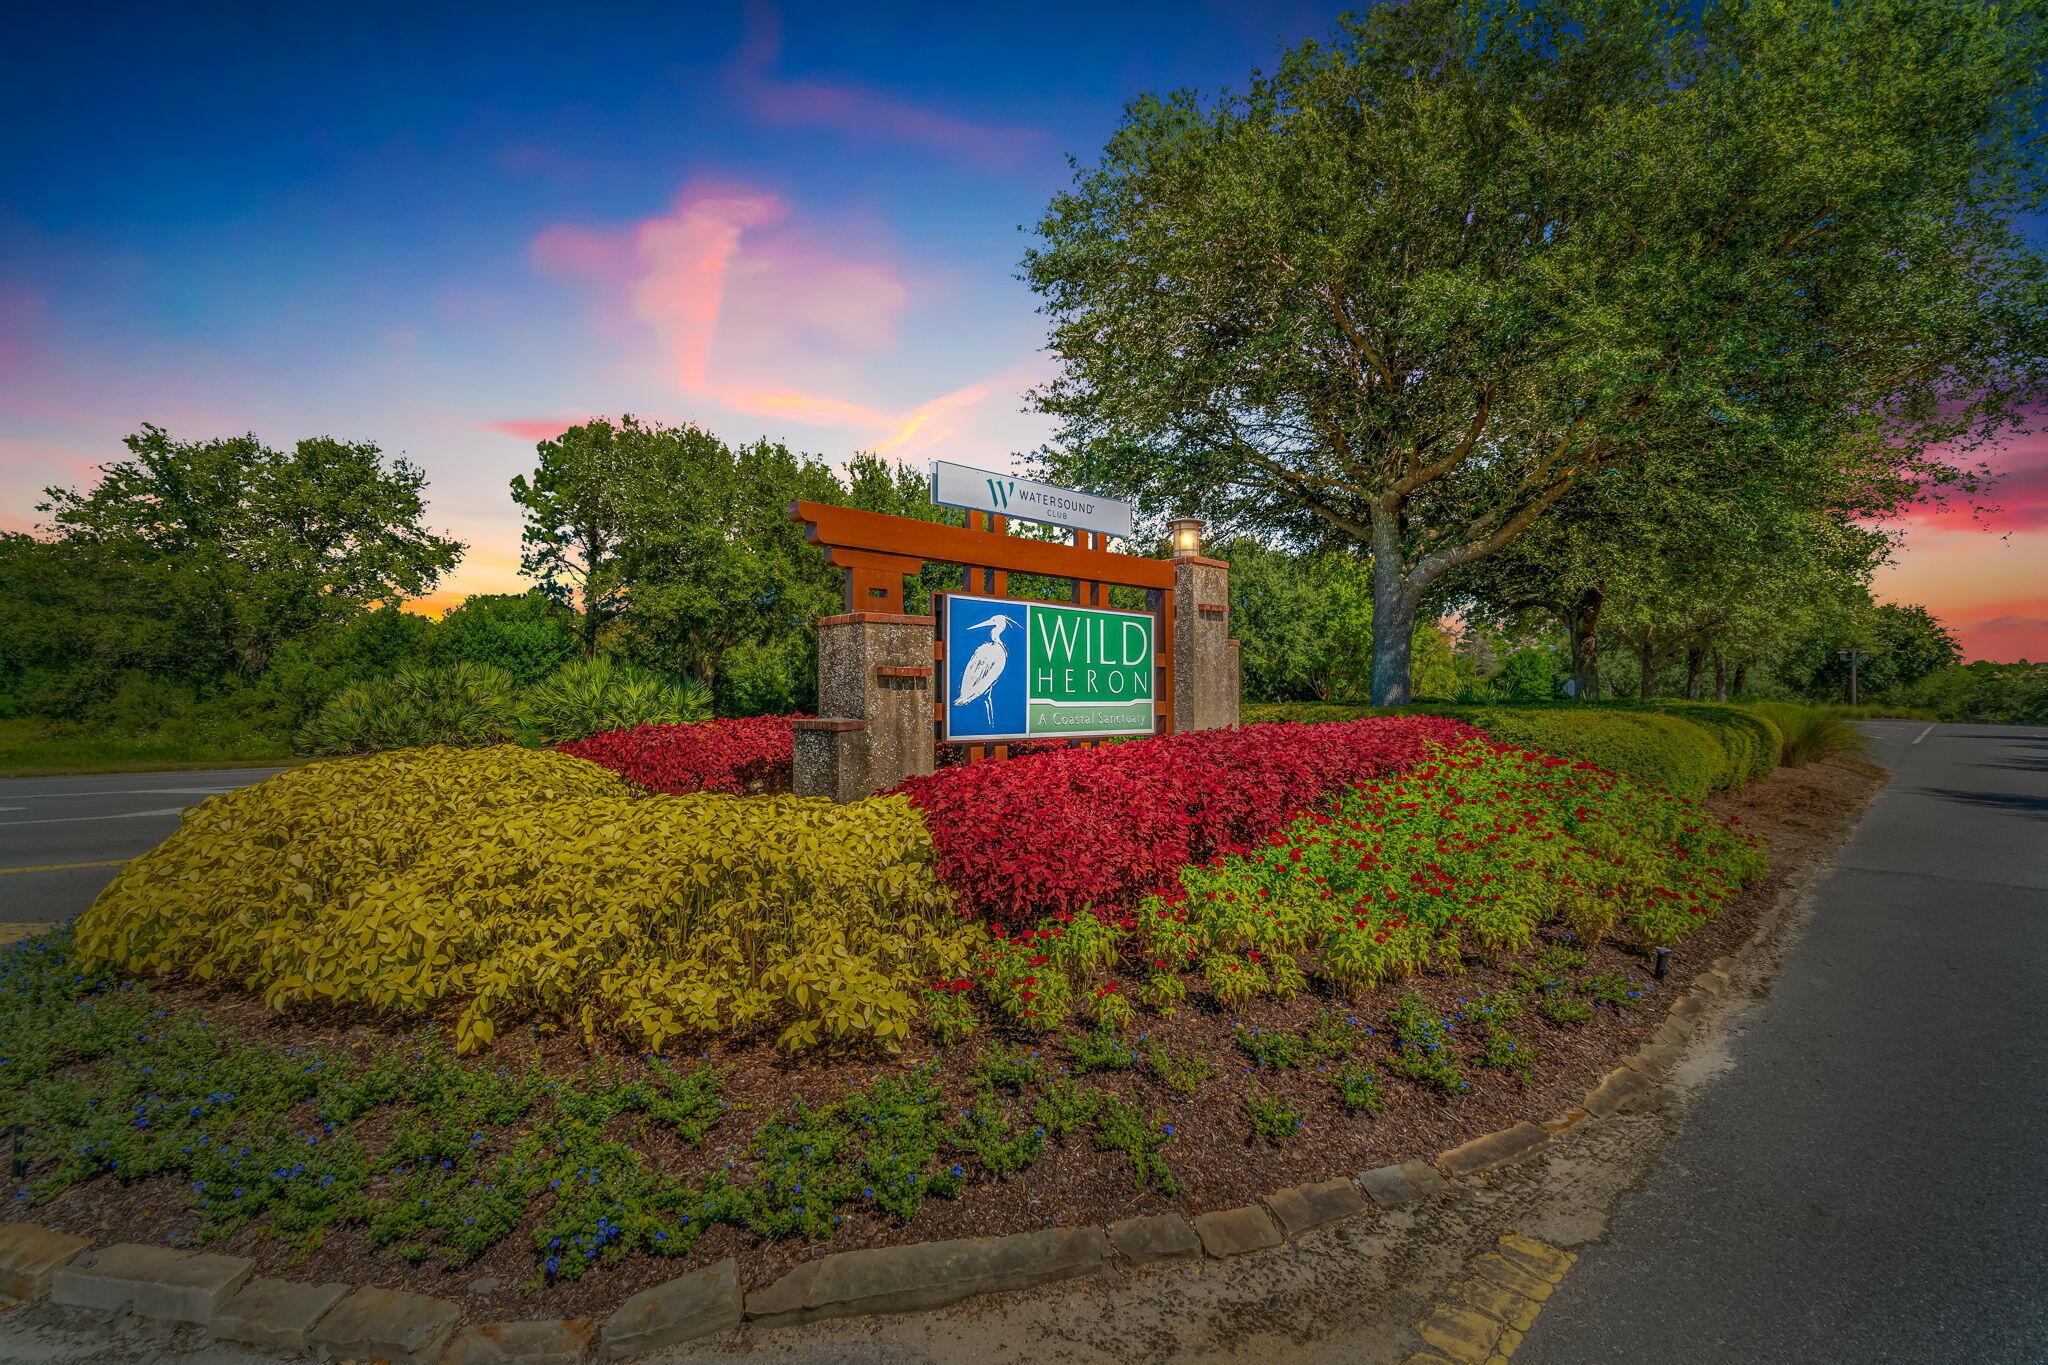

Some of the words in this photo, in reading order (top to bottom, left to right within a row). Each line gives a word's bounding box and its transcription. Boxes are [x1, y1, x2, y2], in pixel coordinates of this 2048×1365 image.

[1019, 489, 1093, 515] WATERSOUND
[1047, 509, 1068, 520] CLUB
[1038, 613, 1148, 666] WILD
[1038, 668, 1147, 693] HERON
[1038, 714, 1047, 726] A
[1053, 711, 1095, 726] Coastal
[1098, 712, 1146, 726] Sanctuary
